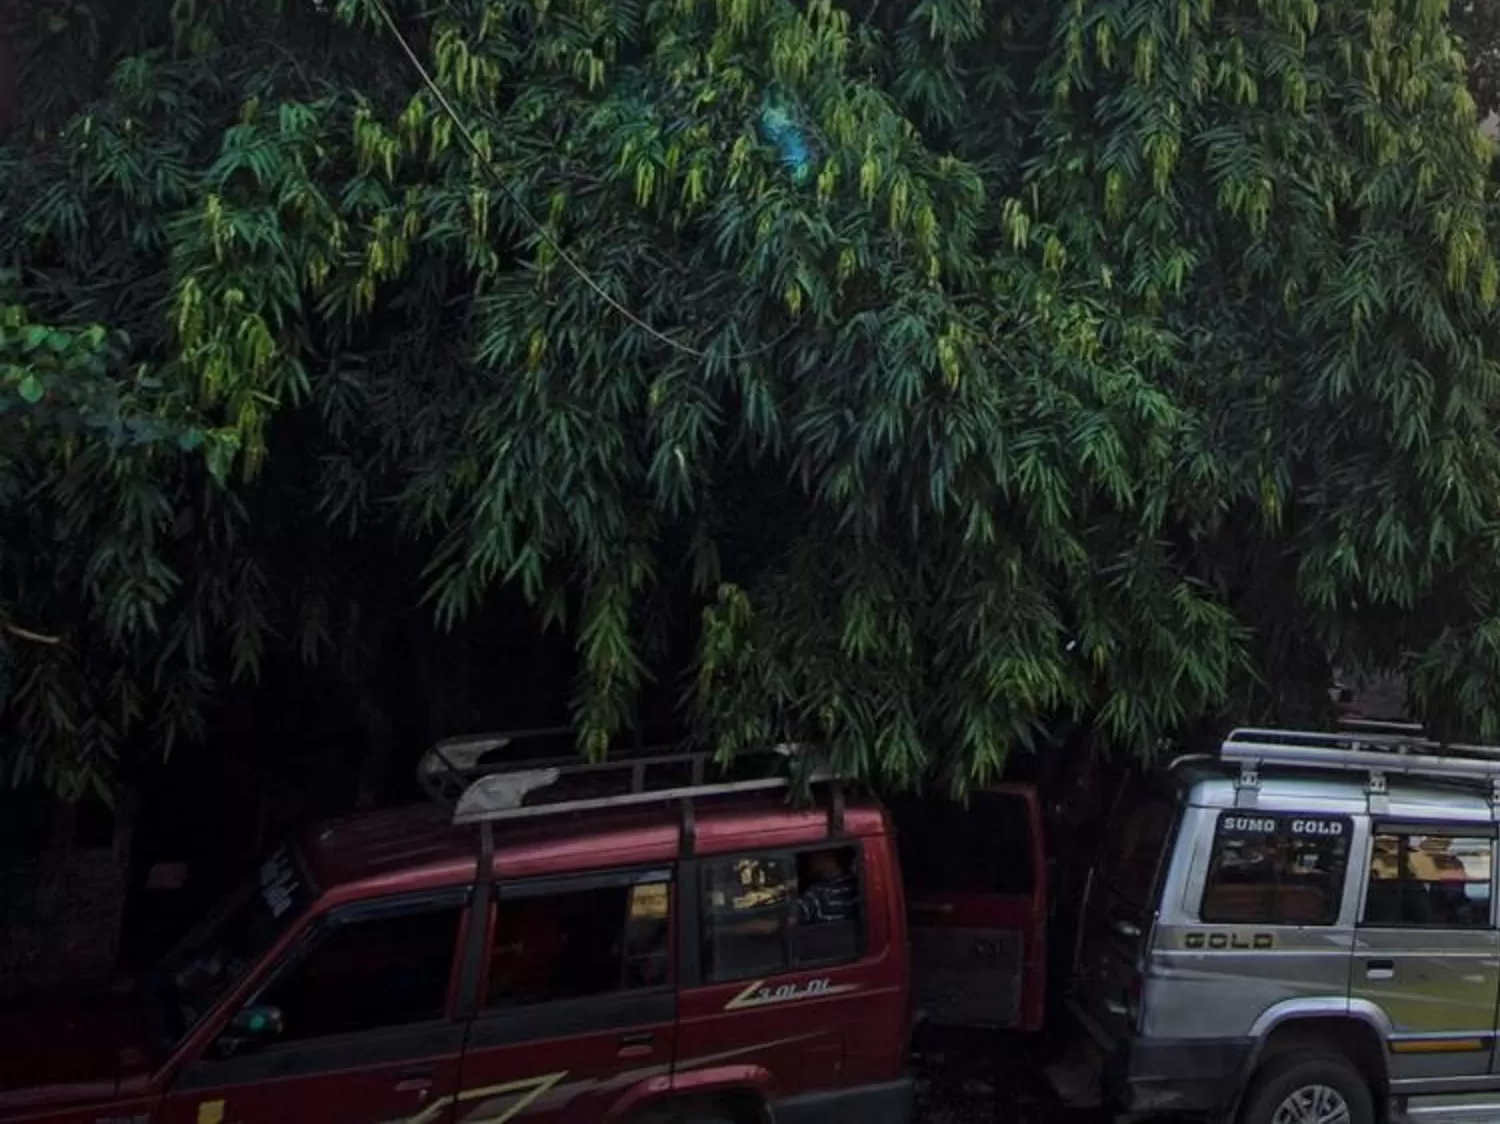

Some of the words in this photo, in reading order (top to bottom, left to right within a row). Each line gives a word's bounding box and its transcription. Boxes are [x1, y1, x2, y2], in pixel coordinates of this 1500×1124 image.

[1223, 817, 1276, 833] SUMO
[1290, 819, 1343, 836] GOLD
[1184, 932, 1273, 949] GOLD
